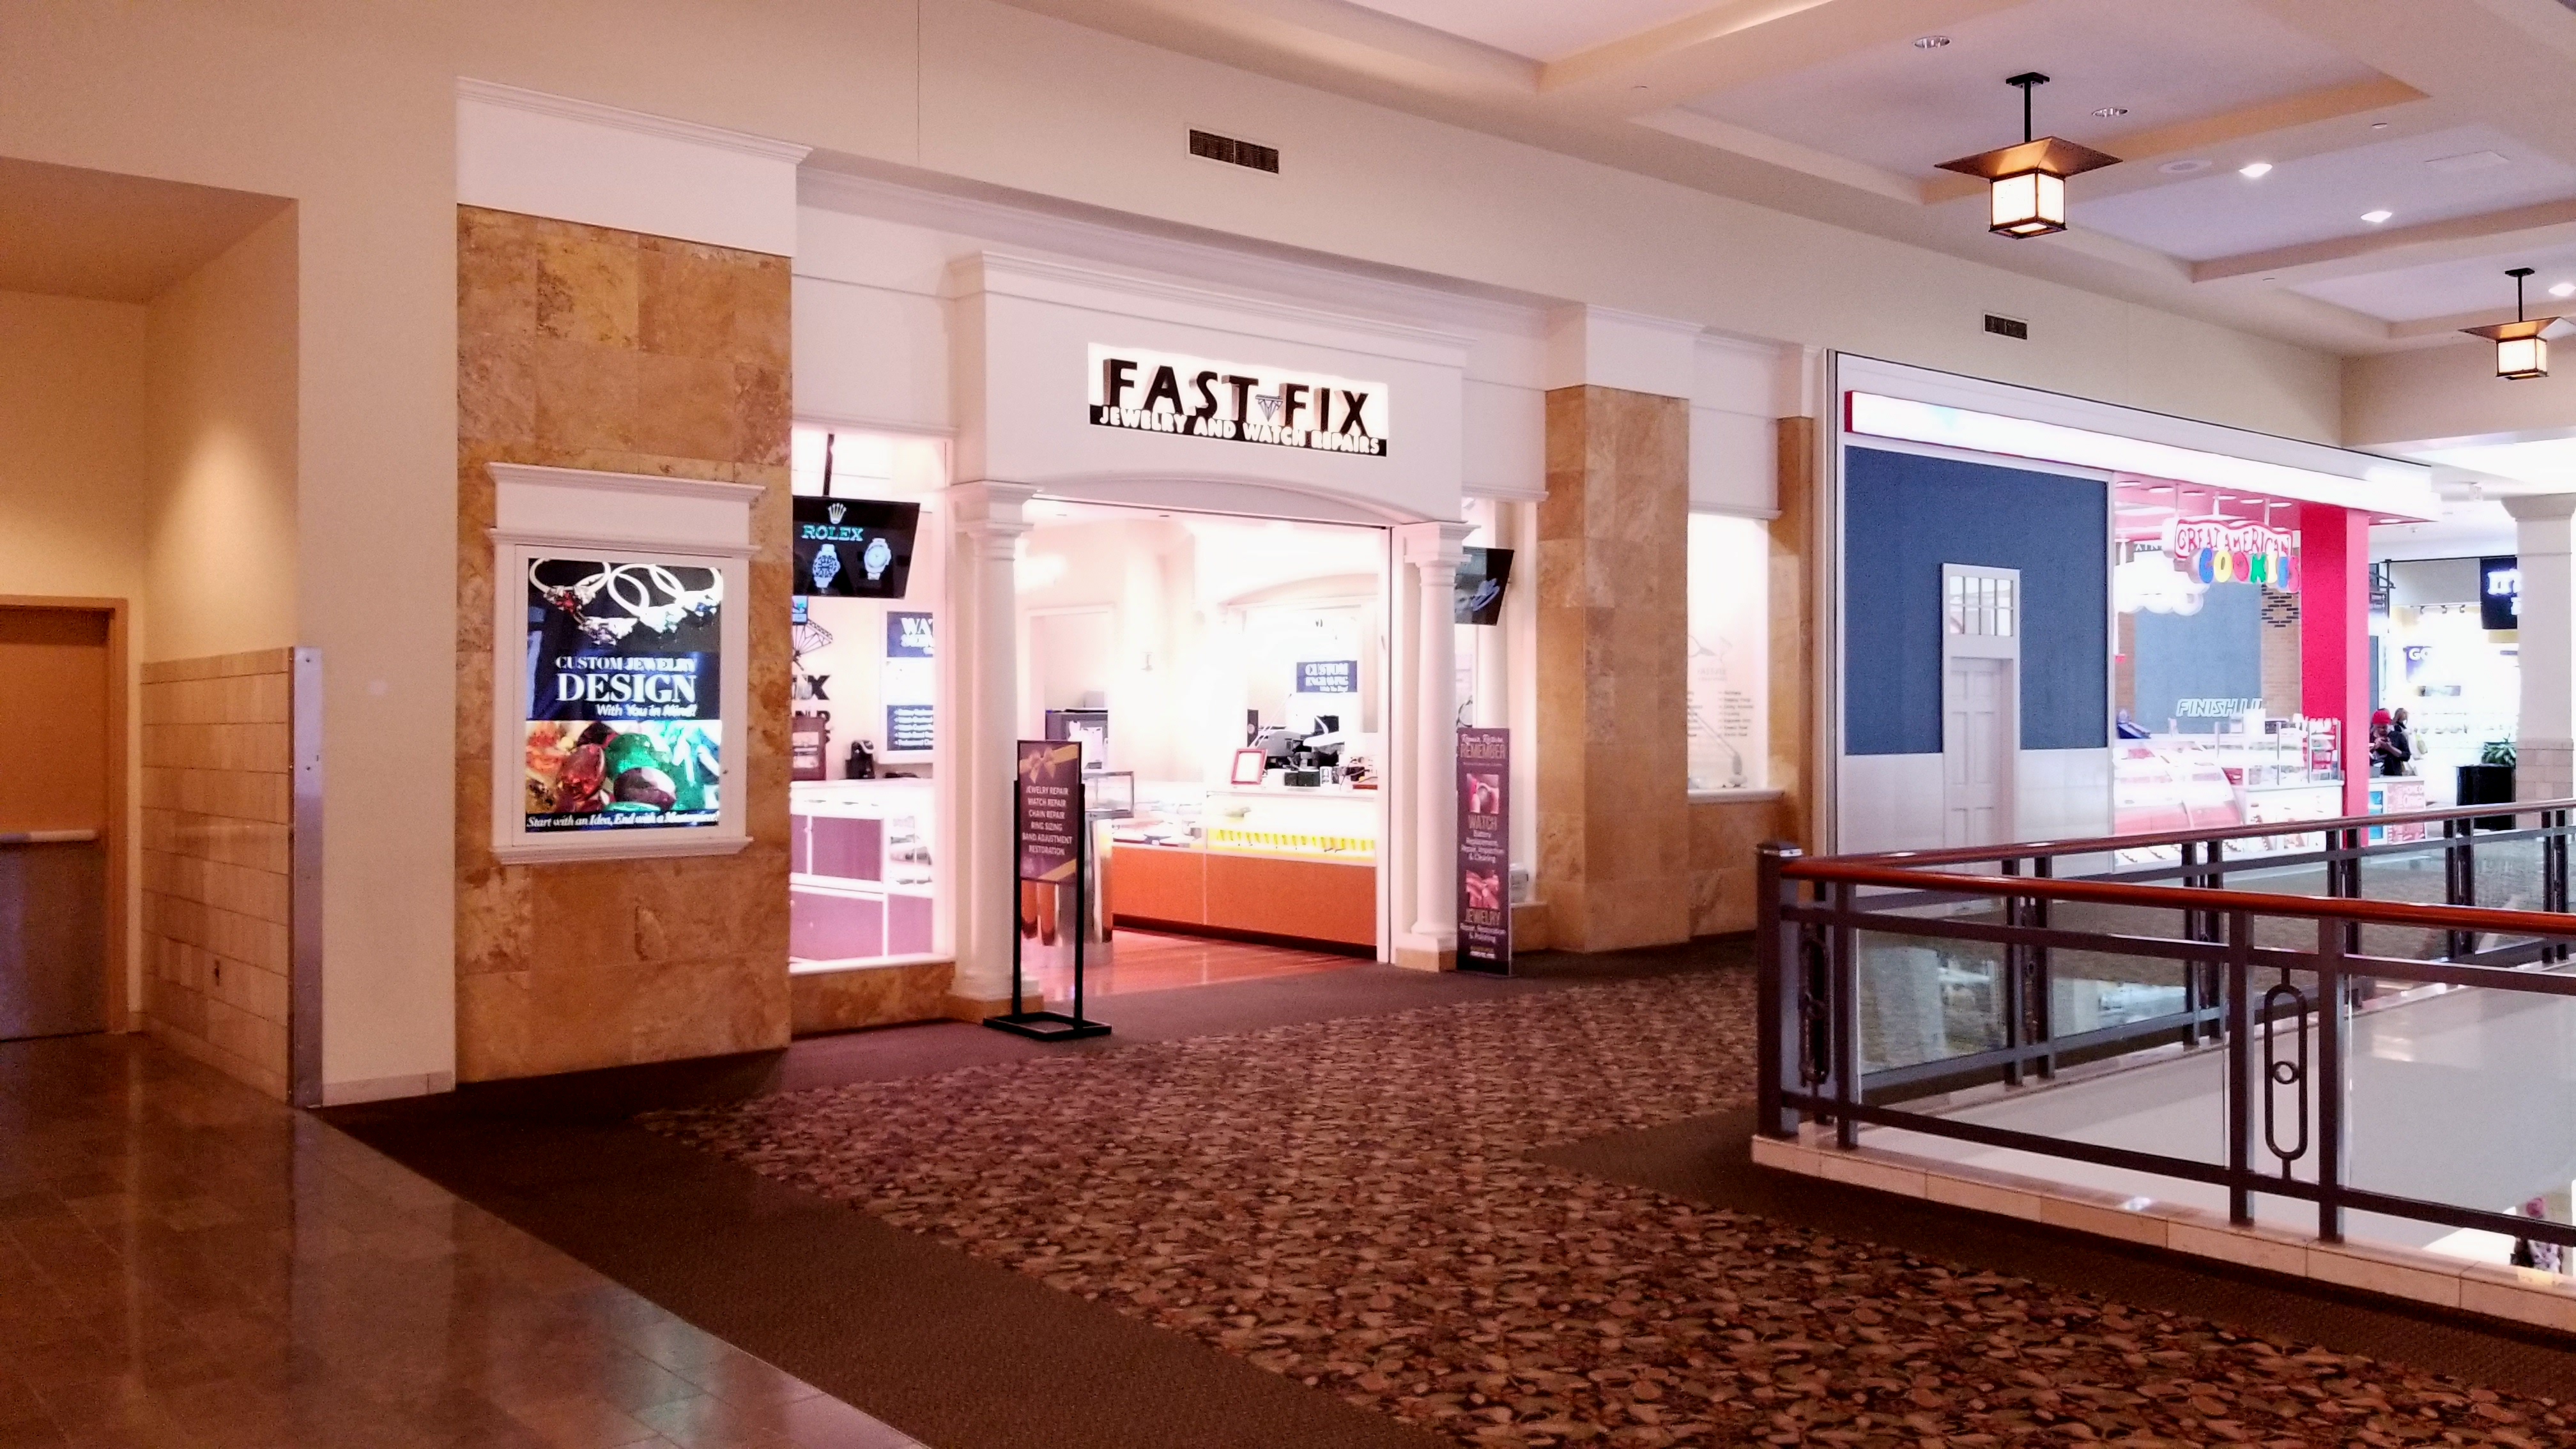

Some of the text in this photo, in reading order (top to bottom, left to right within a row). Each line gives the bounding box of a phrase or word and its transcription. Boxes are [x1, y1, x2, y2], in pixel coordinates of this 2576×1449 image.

[1103, 358, 1369, 437] FAST FIX
[1100, 406, 1379, 454] JEWELRY AND WATCH REPAIRS
[801, 525, 864, 541] ROLEX
[2177, 527, 2290, 556] GREAT AMERICAN
[555, 656, 697, 672] CUSTOM JEWELRY
[1305, 663, 1348, 675] CUSTOM
[555, 673, 697, 703] DESIGN
[597, 704, 623, 716] With
[626, 704, 648, 716] You
[649, 704, 662, 717] in
[2176, 698, 2238, 717] FINISH
[1026, 785, 1069, 795] JEWELRY REPAIR
[1028, 797, 1066, 807] WATCH REPAIR
[526, 816, 551, 827] Start
[553, 815, 574, 826] with
[575, 817, 588, 826] an
[588, 814, 613, 826] Idea,
[613, 813, 636, 825] End
[635, 812, 656, 824] with
[656, 815, 664, 823] a
[1029, 809, 1065, 819] CHAIN REPAIR
[1031, 821, 1062, 831] RING SIZING
[1022, 832, 1073, 844] BAND ADJUSTMENT
[1029, 845, 1065, 855] RESTORATION
